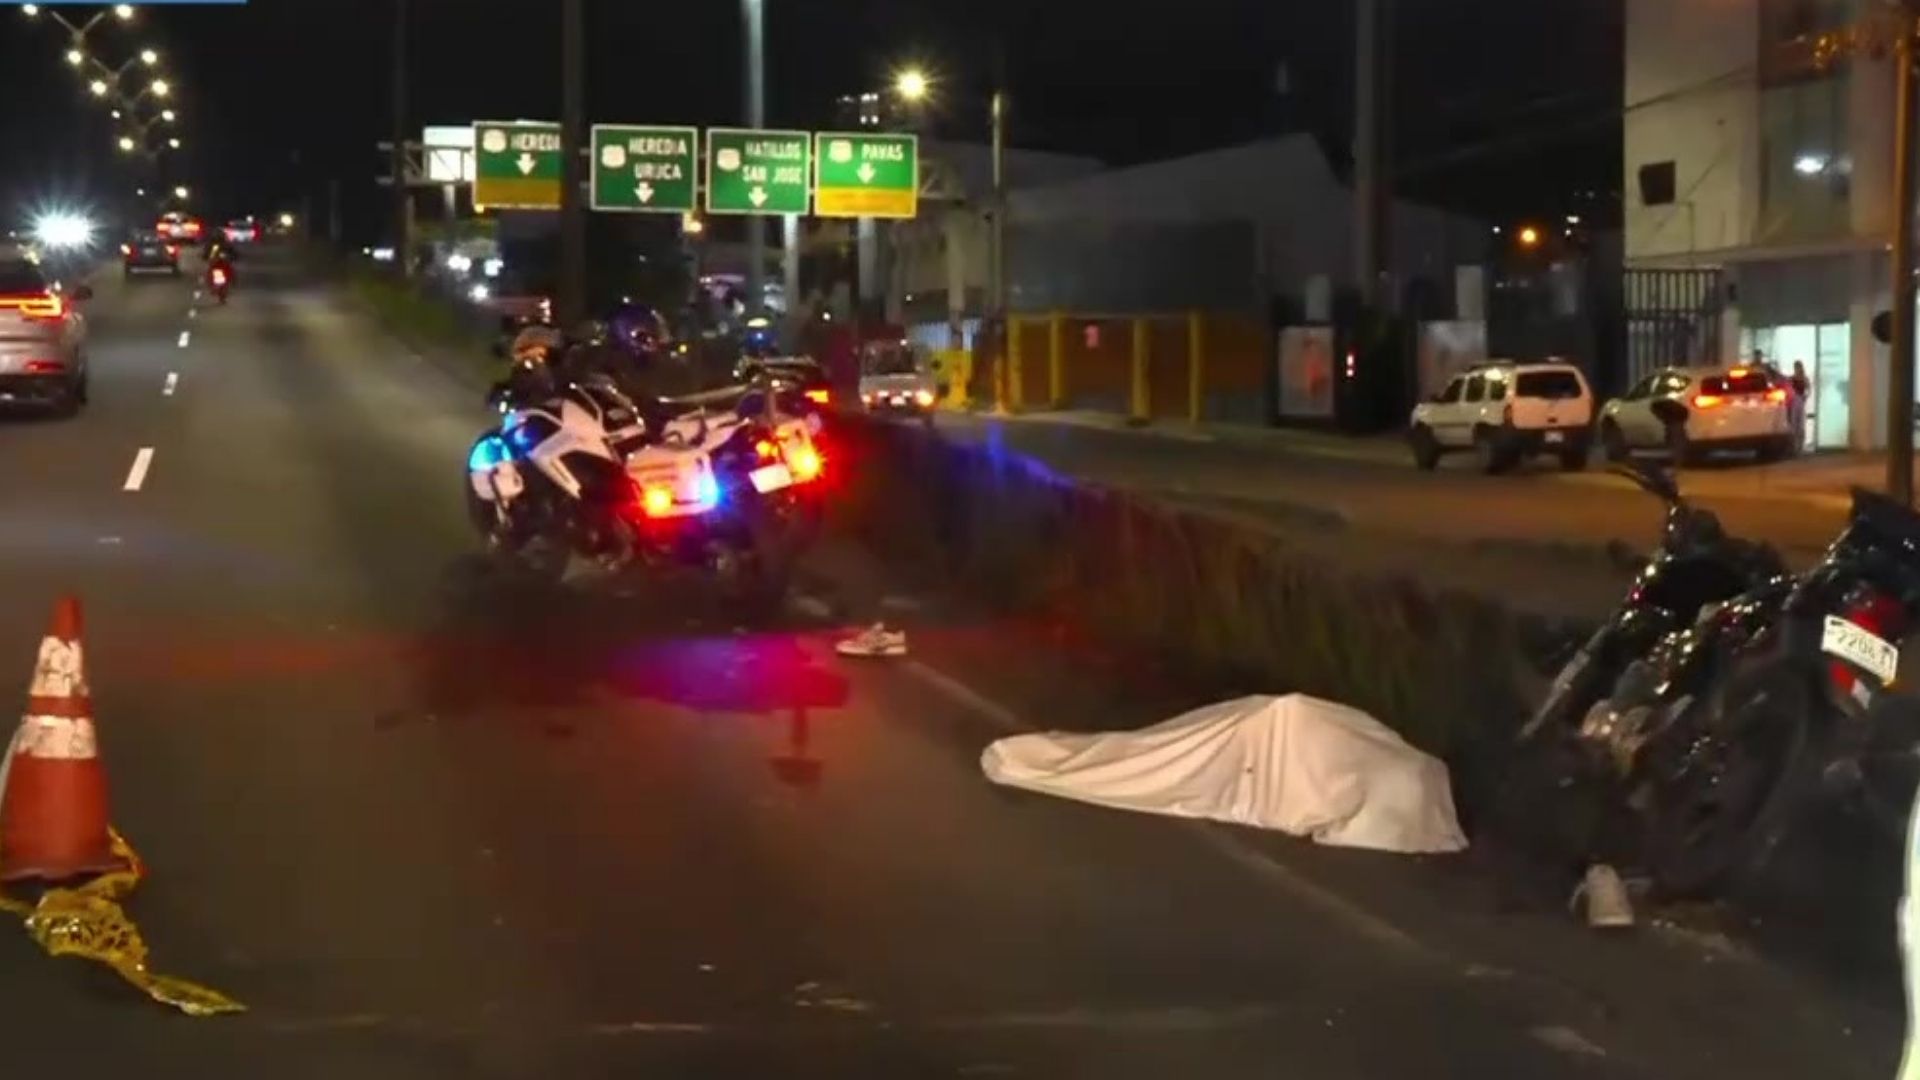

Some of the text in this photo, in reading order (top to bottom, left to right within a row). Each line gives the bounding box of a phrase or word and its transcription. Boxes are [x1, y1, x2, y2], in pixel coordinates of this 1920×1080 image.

[628, 137, 687, 155] HEREDIA
[744, 140, 801, 160] HATILLOS
[861, 143, 904, 161] PAVAS
[634, 162, 682, 180] URUCA
[742, 164, 802, 184] SAN JOSE
